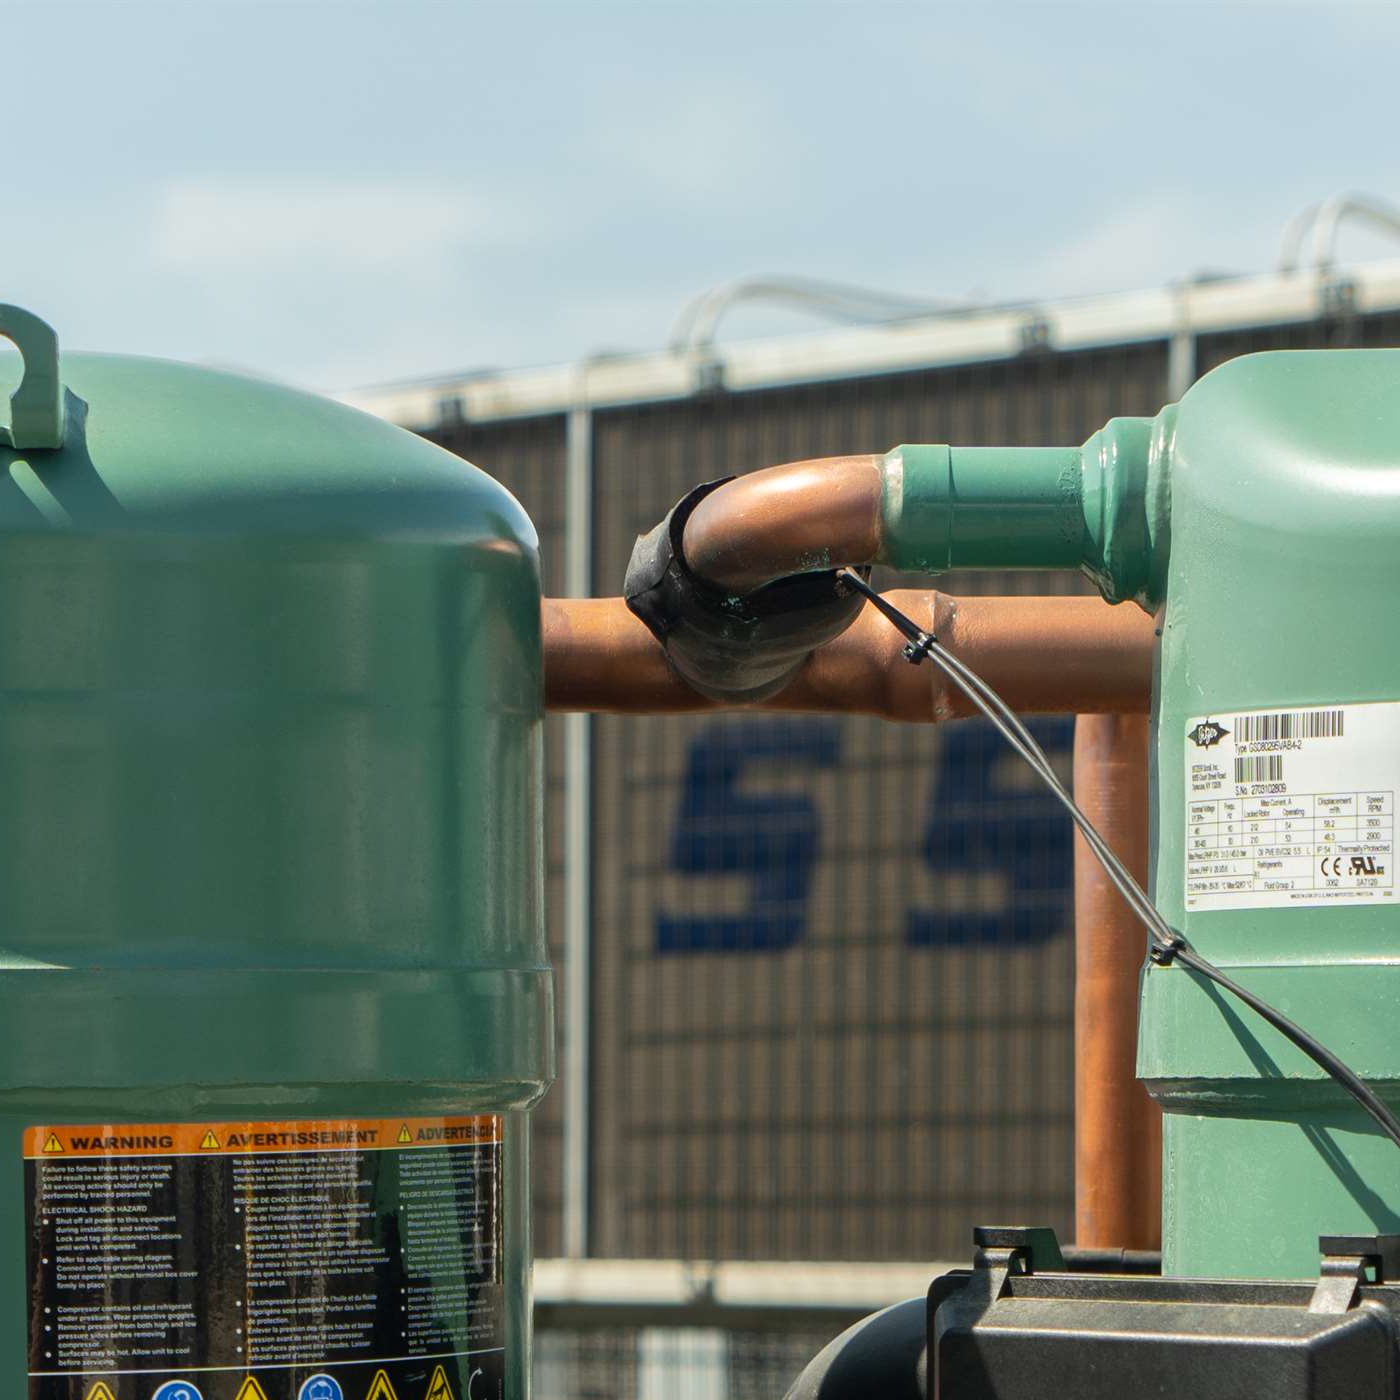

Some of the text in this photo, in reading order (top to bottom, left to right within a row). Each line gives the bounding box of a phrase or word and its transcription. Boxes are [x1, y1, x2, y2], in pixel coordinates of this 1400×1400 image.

[1366, 796, 1384, 804] Speed
[1368, 804, 1382, 812] RPM
[1338, 843, 1390, 854] Thermally Protected
[71, 1135, 174, 1150] WARNING
[226, 1129, 379, 1147] AVERTISSEMENT
